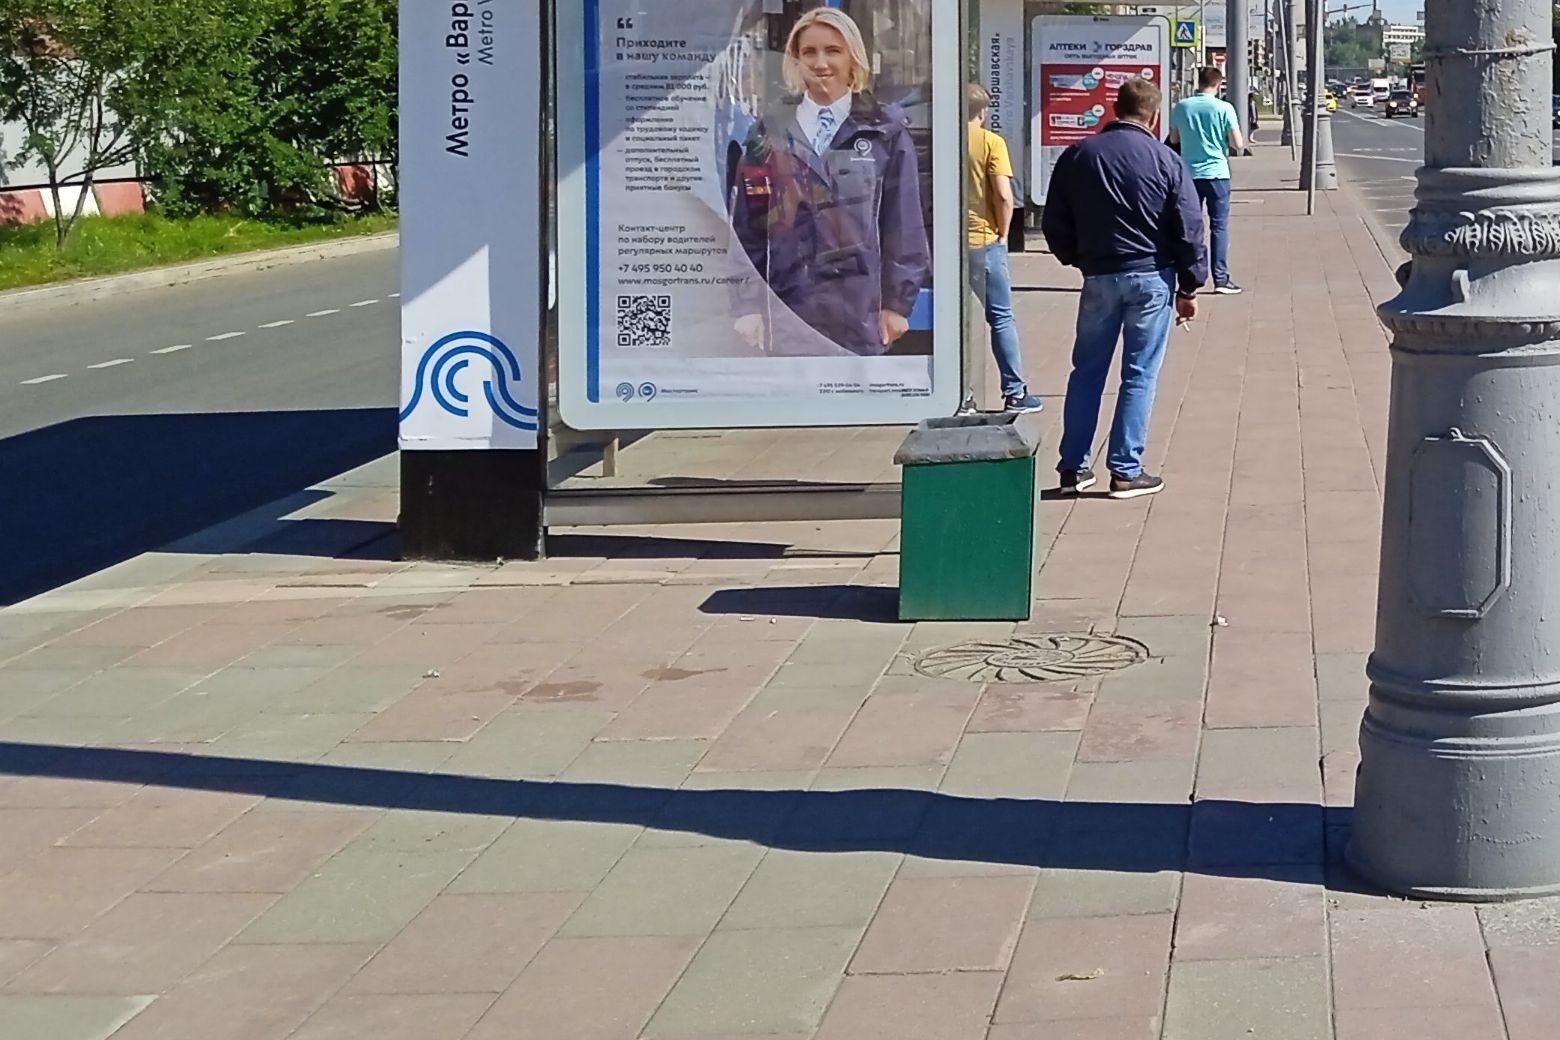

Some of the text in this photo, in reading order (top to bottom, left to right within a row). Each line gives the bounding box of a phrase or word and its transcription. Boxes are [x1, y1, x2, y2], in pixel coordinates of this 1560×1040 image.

[478, 9, 493, 65] Metro
[616, 37, 687, 48] Приходите
[1105, 43, 1153, 51] ГОРЗДРАВ
[616, 52, 716, 63] в нашу команду
[446, 73, 474, 157] Метро
[618, 224, 686, 234] Контакт-центр
[632, 235, 665, 245] набору
[667, 235, 716, 244] водителей
[618, 248, 727, 256] регулярных маршрутов
[618, 264, 703, 272] +7 495 950 40 40
